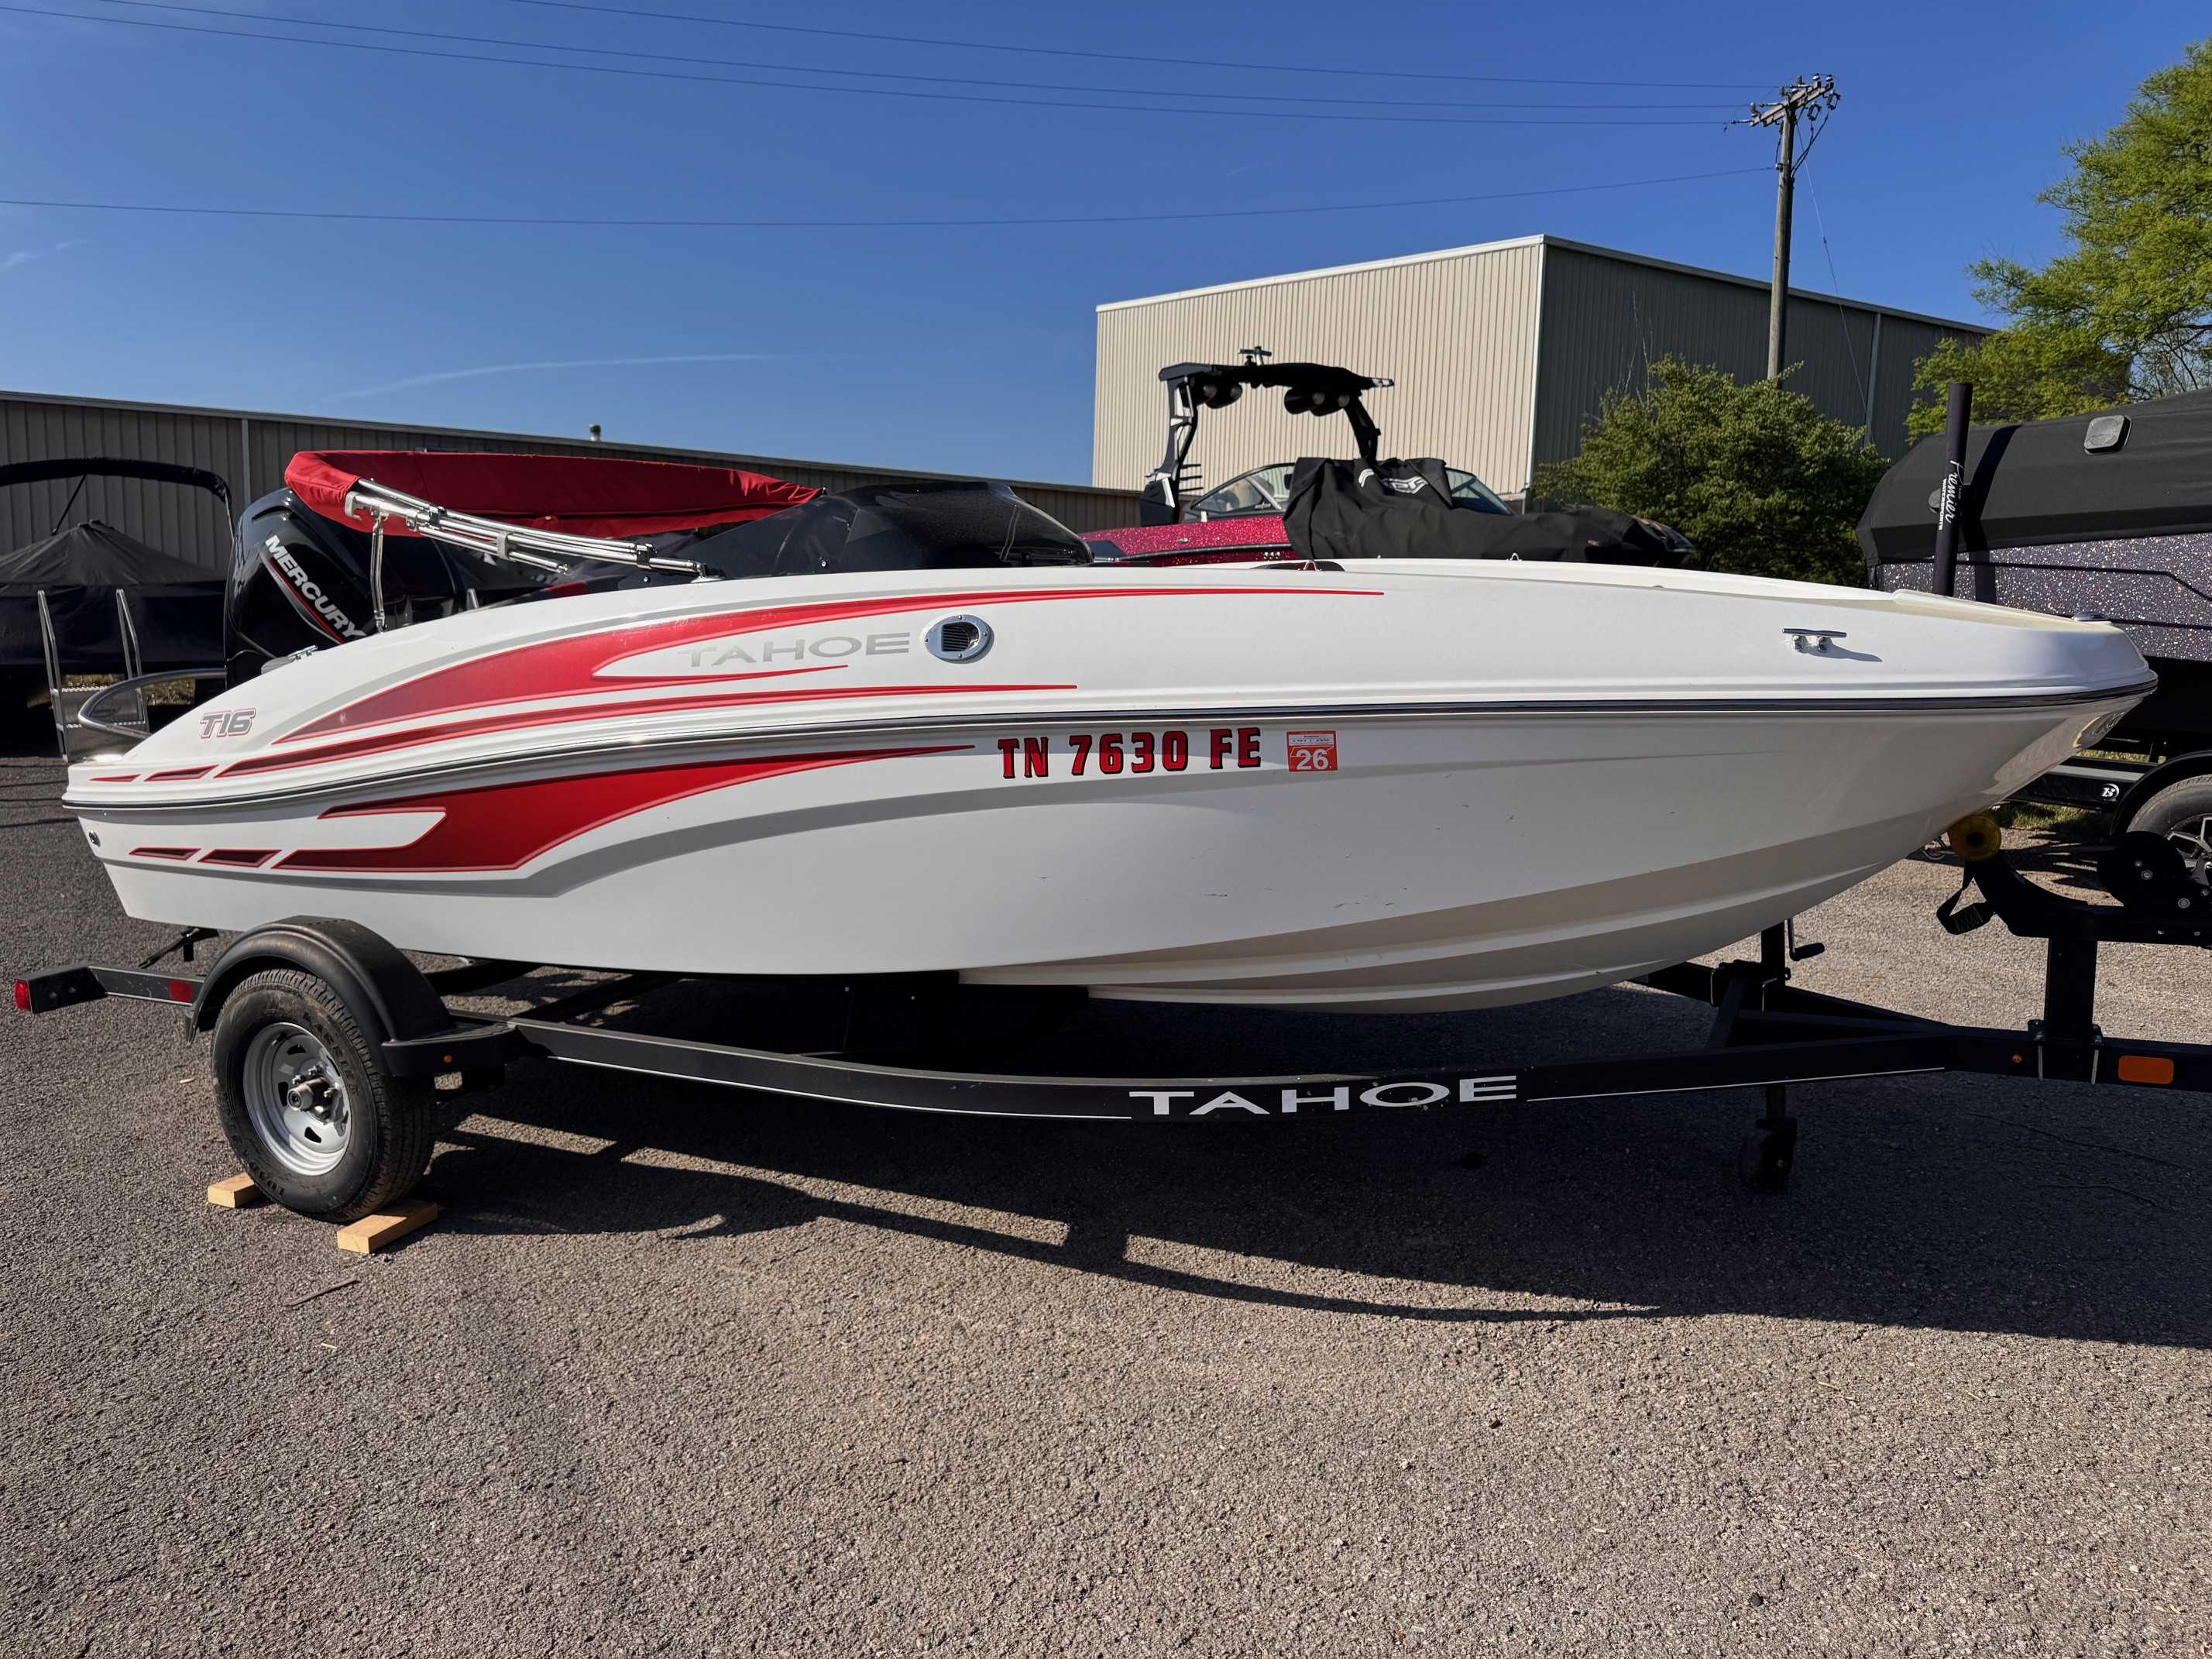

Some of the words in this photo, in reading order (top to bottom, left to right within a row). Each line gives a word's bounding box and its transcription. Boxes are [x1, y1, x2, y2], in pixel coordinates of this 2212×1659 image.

[265, 534, 367, 637] MERCURY
[678, 632, 911, 668] TAHOE
[200, 707, 256, 739] T16
[998, 737, 1049, 779] TN
[1069, 731, 1189, 776] 7630
[1209, 727, 1262, 769] FE
[1296, 748, 1329, 771] 26
[1128, 1075, 1517, 1115] TAHOE
